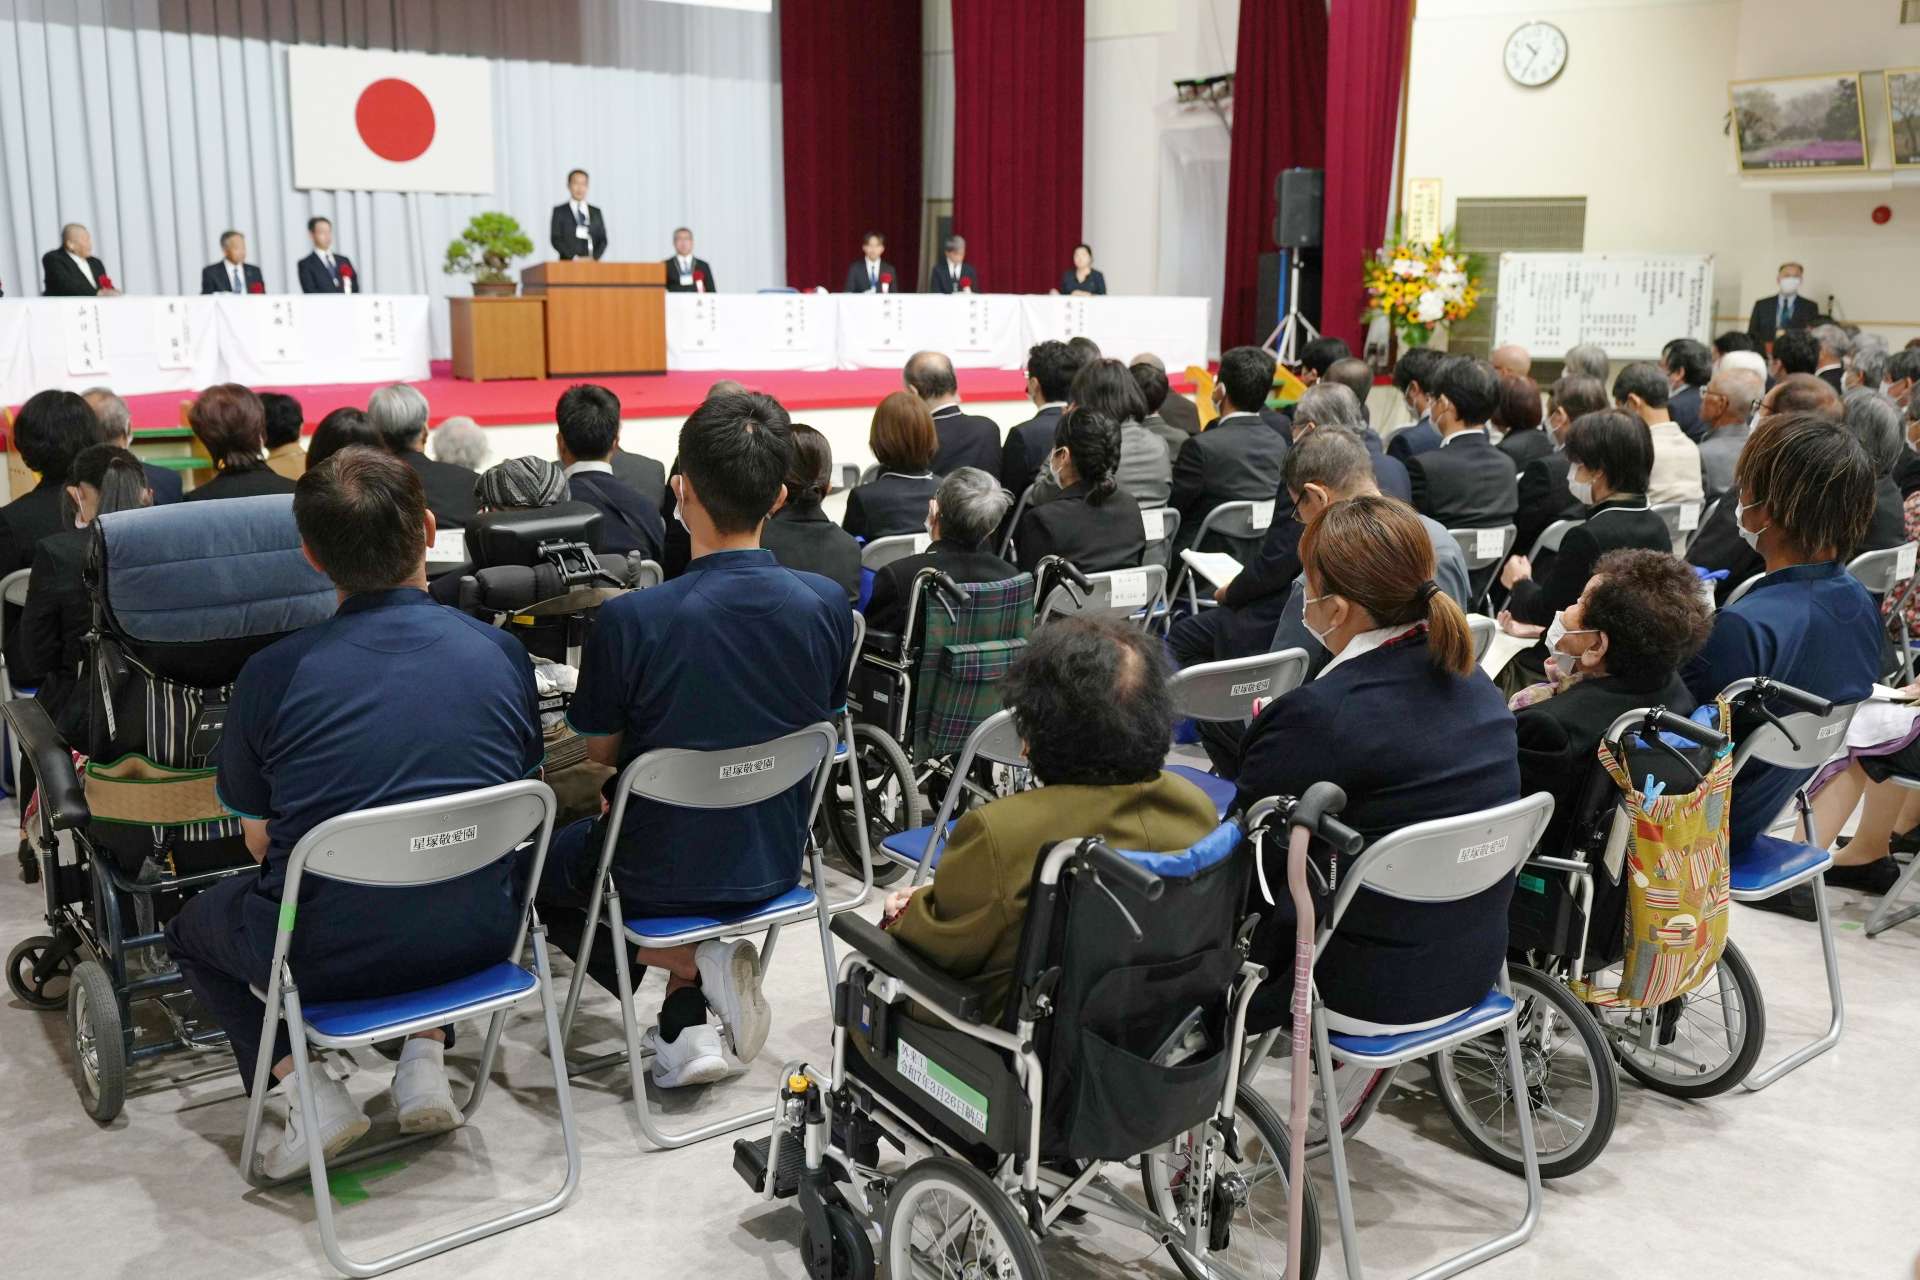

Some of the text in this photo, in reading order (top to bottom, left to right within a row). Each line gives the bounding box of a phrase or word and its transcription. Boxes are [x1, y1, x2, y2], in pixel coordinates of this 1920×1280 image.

[722, 758, 773, 777] 星塚敬愛園
[413, 827, 476, 849] 星塚敬愛園
